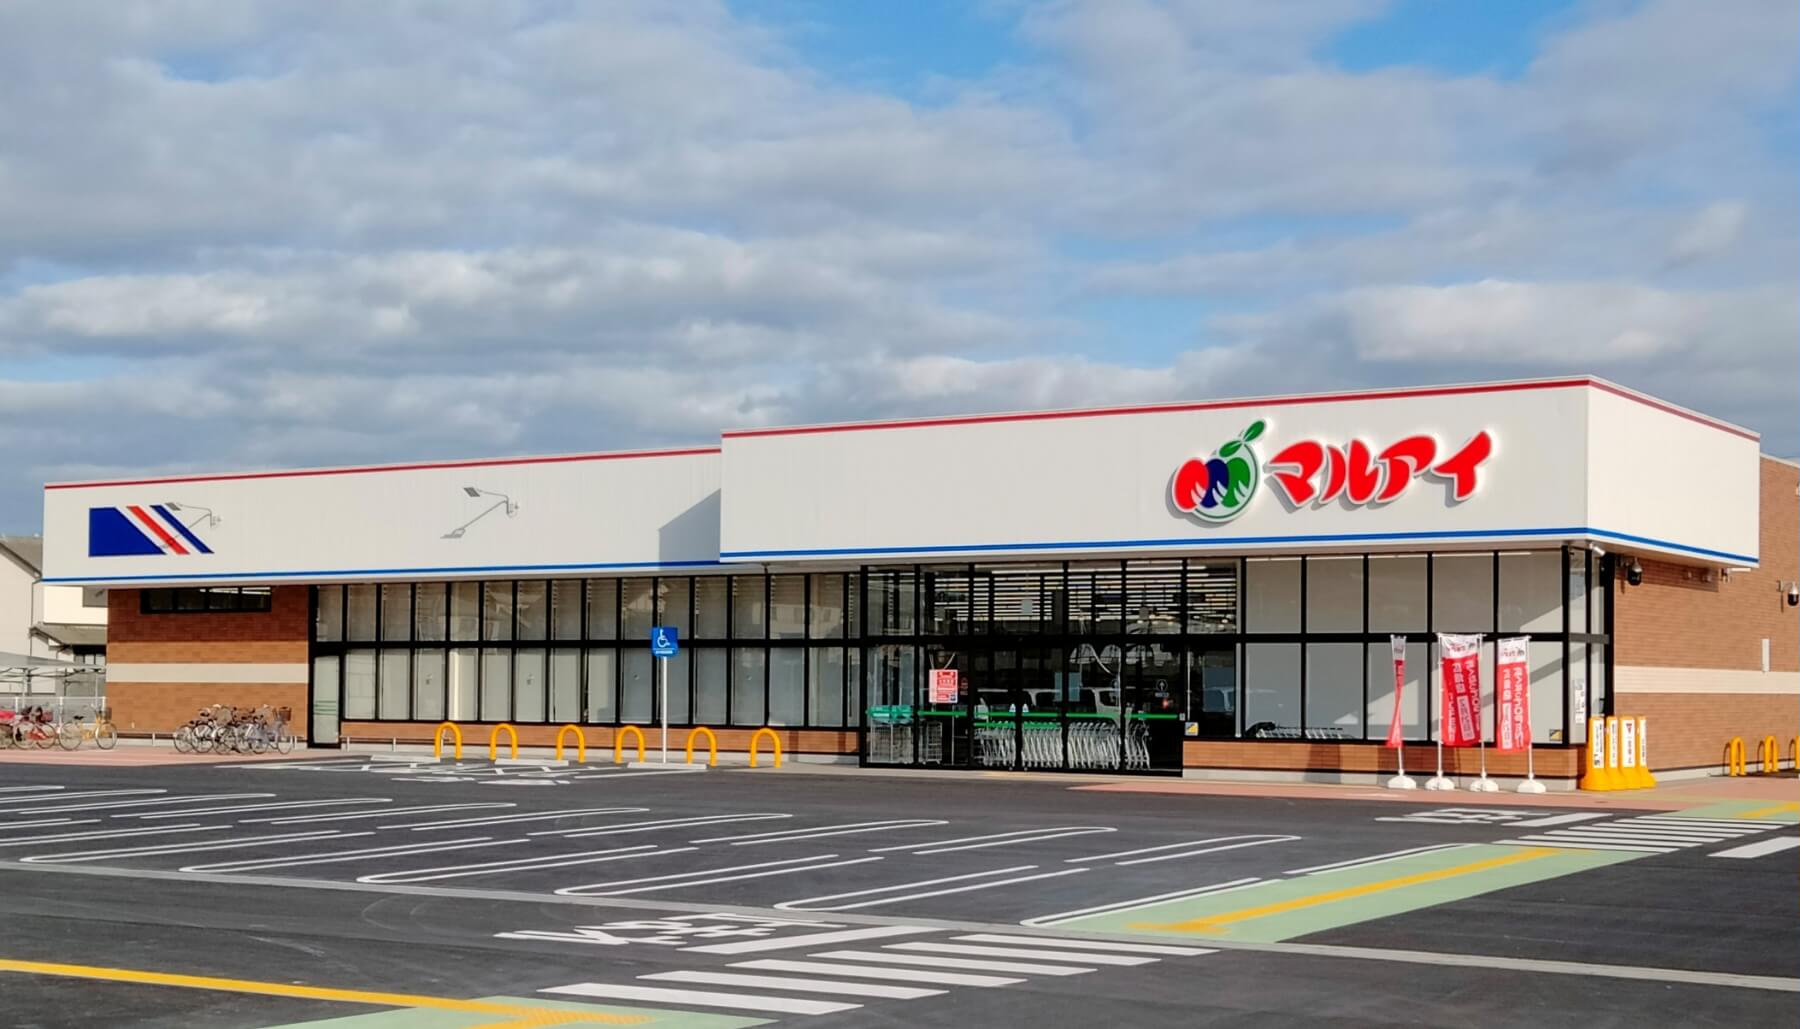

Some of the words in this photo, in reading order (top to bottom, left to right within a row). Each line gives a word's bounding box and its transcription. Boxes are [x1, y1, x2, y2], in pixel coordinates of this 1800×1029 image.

[1267, 430, 1493, 506] マルアイ
[493, 912, 848, 946] 止まれ
